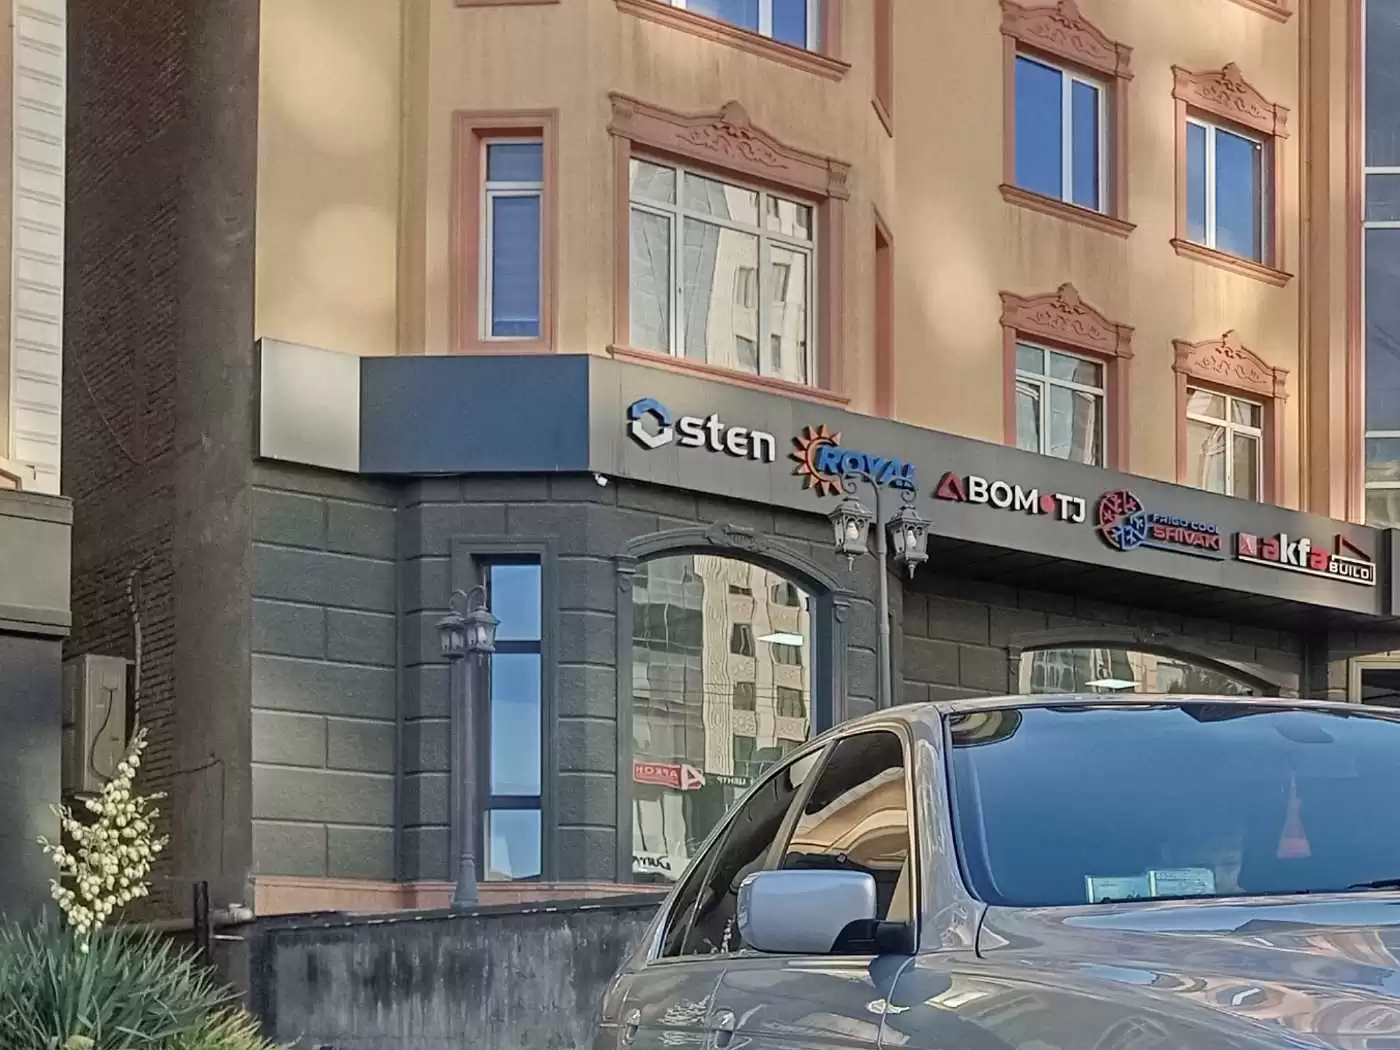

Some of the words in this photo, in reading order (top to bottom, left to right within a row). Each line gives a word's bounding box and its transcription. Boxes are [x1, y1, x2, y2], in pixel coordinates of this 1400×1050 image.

[1153, 524, 1223, 553] SHIVAKI
[1262, 533, 1329, 571] akfa
[1329, 561, 1370, 580] BUILD
